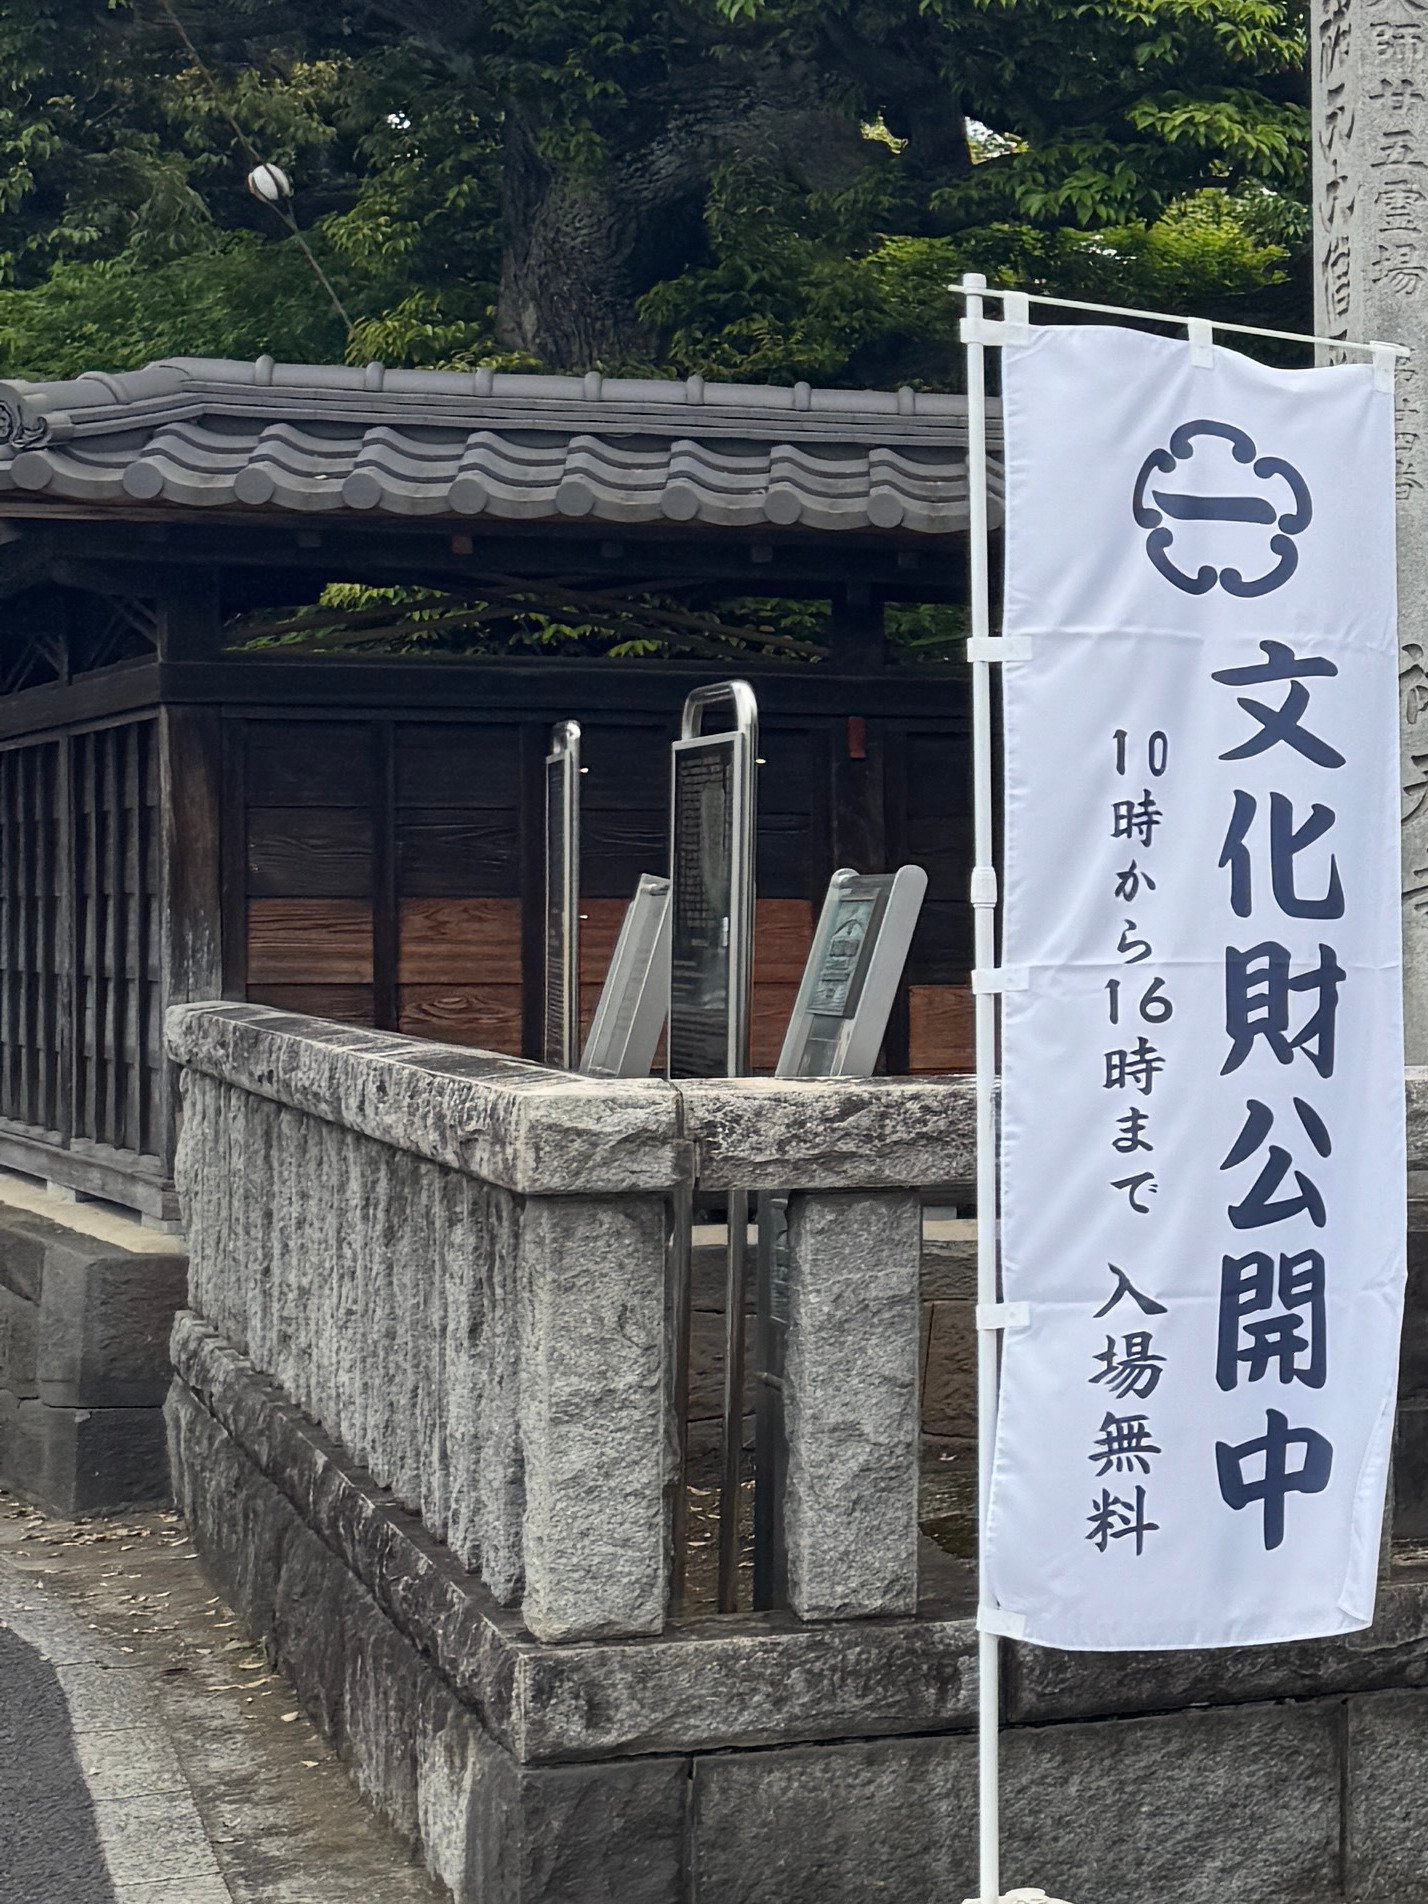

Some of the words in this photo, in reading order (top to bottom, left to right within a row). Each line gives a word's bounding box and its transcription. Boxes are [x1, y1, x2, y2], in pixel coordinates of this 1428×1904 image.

[1102, 729, 1173, 1214] 10時から16時まで
[1212, 640, 1346, 1550] 文化財公開中
[1085, 1263, 1168, 1556] 入場無料
